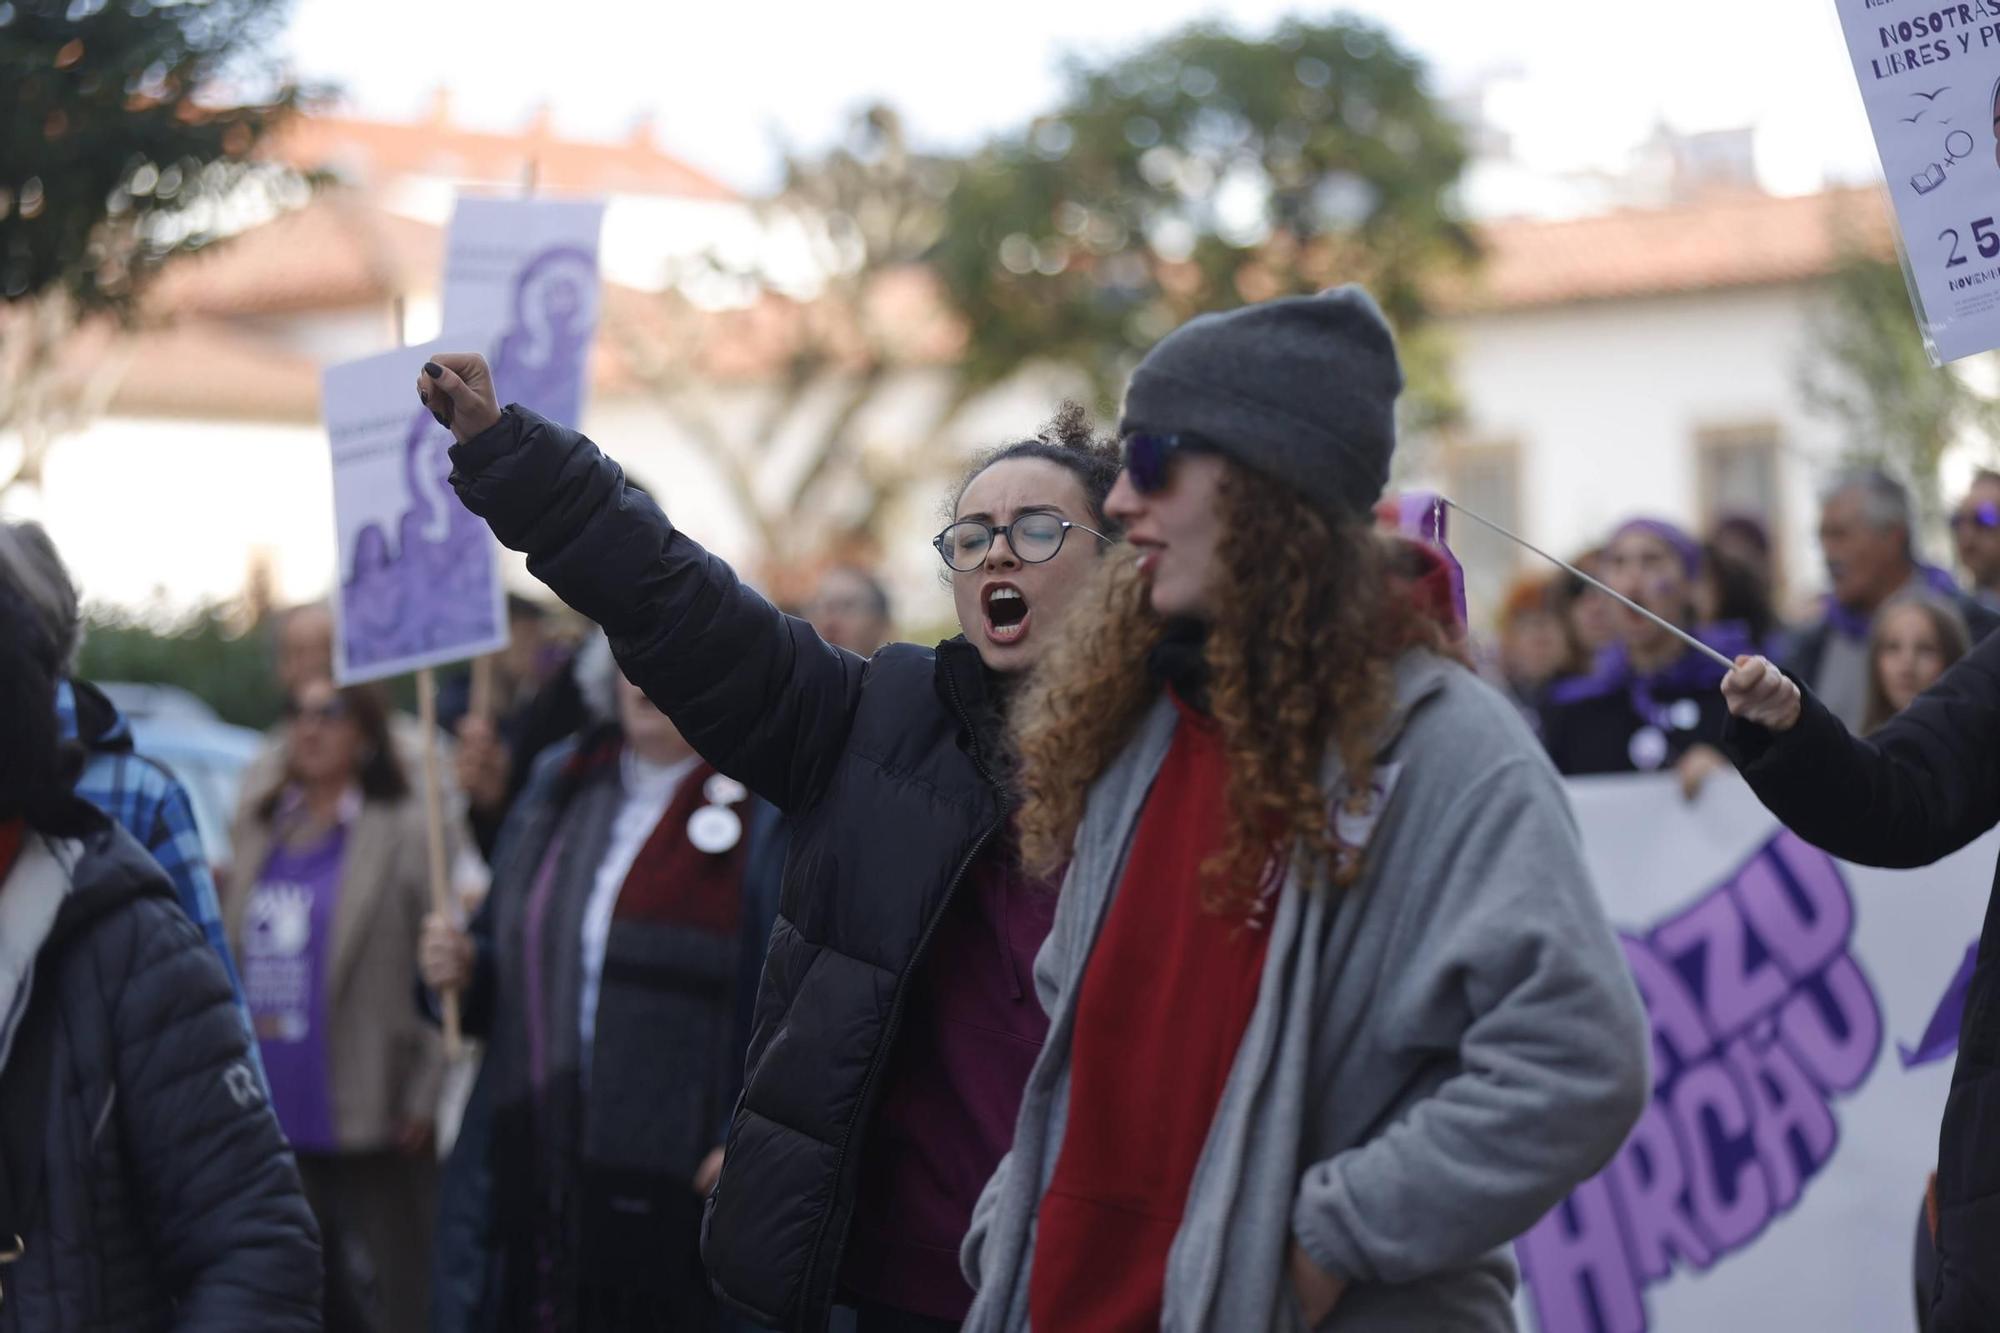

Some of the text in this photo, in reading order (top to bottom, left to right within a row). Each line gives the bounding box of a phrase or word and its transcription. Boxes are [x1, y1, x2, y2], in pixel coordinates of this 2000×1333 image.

[1878, 0, 2000, 48] NOSOTRAS
[1871, 39, 1951, 80] LIBRES
[1938, 216, 2000, 269] 25
[1949, 266, 2000, 291] NOVIEMB
